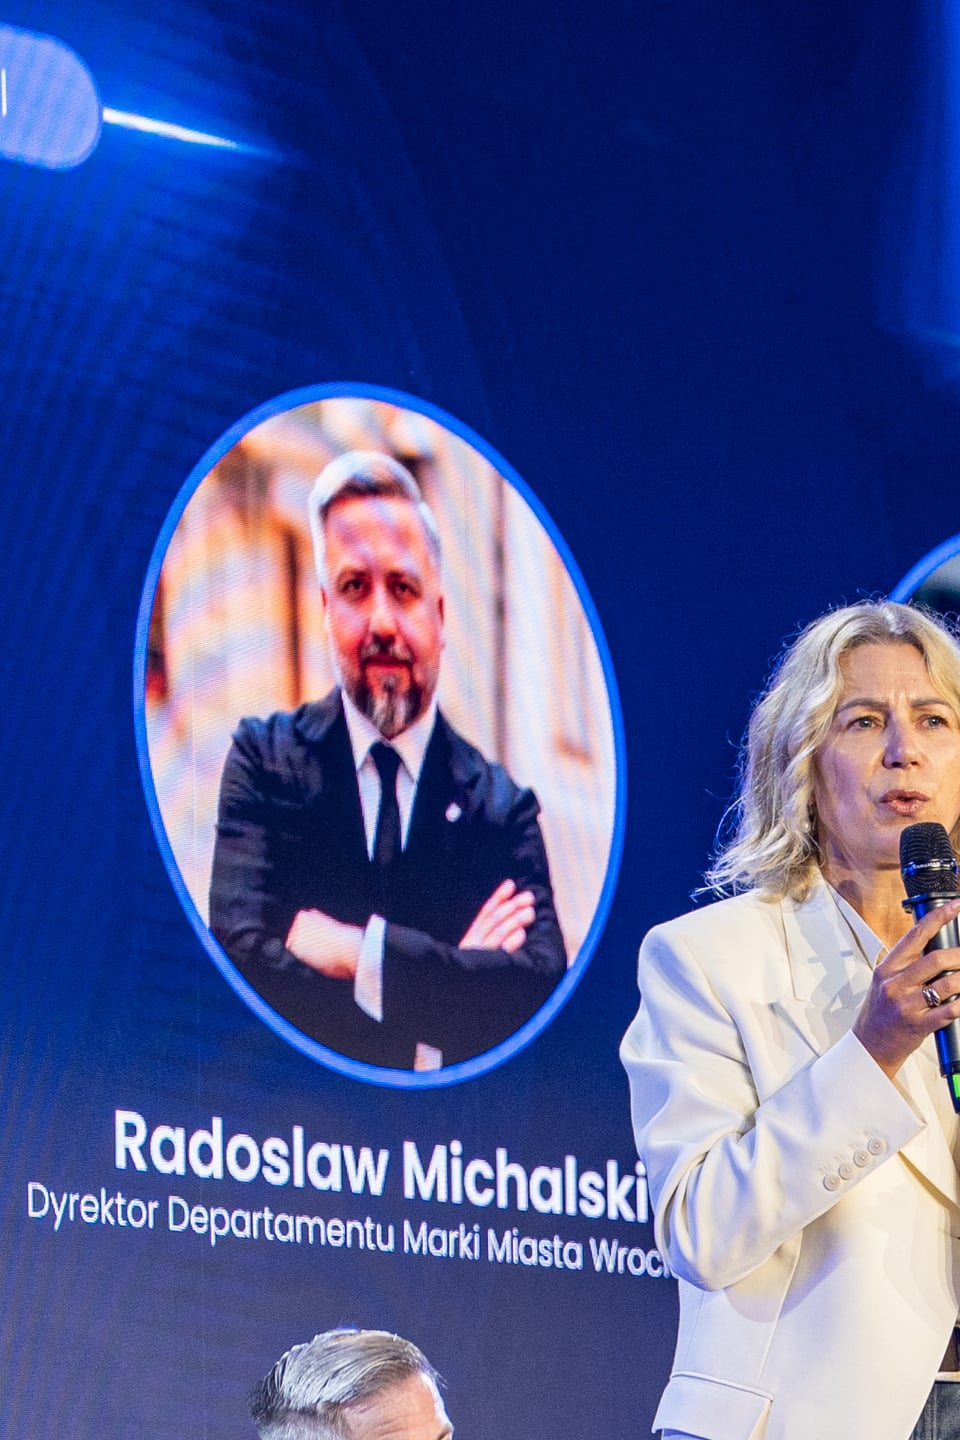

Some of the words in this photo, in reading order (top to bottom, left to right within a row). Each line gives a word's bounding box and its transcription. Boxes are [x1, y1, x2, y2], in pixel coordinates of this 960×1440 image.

[114, 1108, 390, 1196] Radoslaw
[403, 1139, 649, 1223] Michalski
[27, 1181, 159, 1232] Dyrektor
[168, 1195, 395, 1253] Departamentu
[402, 1219, 481, 1261] Marki
[487, 1226, 583, 1271] Miasta
